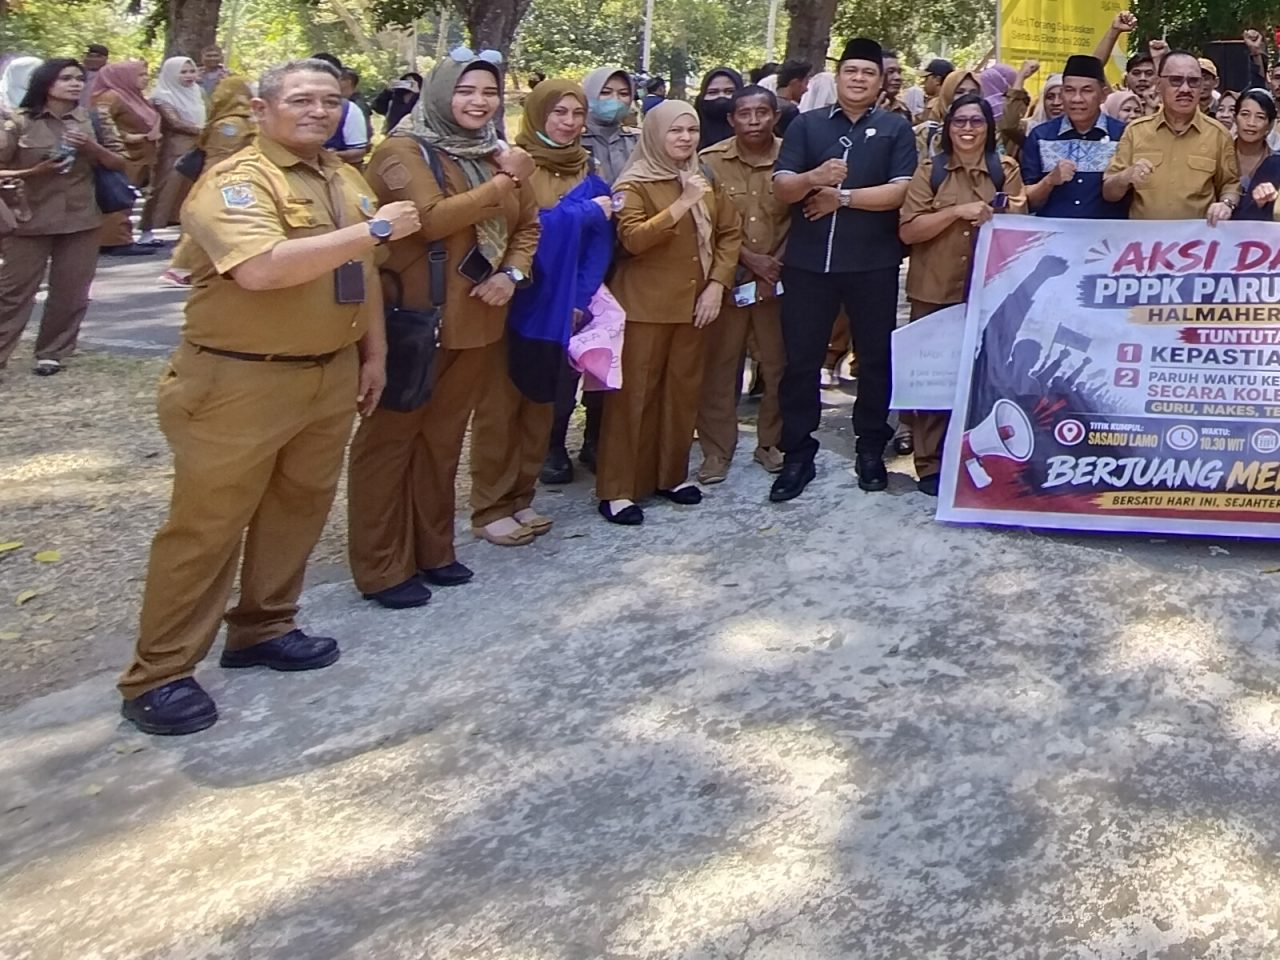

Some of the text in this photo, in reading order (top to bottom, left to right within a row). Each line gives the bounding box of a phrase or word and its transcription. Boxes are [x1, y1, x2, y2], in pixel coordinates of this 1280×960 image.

[1030, 18, 1056, 32] Torang
[1011, 30, 1040, 42] Sensus
[1041, 33, 1072, 45] Ekonomi
[1112, 239, 1221, 273] AKSI
[1094, 277, 1188, 304] PPPK
[1123, 346, 1134, 361] 1
[1119, 370, 1133, 385] 2
[1149, 371, 1199, 384] PARUH
[1203, 373, 1257, 386] WAKTU
[1262, 376, 1279, 387] KE
[1147, 384, 1224, 400] SECARA
[1151, 402, 1198, 415] GURU,
[1203, 404, 1259, 417] NAKES,
[1090, 422, 1144, 431] TITIK KUMPUL:
[1201, 427, 1231, 436] WAKTU:
[1088, 432, 1158, 448] SASADU LAMO
[1200, 437, 1245, 451] 10.30 WIT
[1041, 455, 1225, 489] BERJUANG
[1112, 495, 1163, 506] BERSATU
[1166, 497, 1194, 507] HARI
